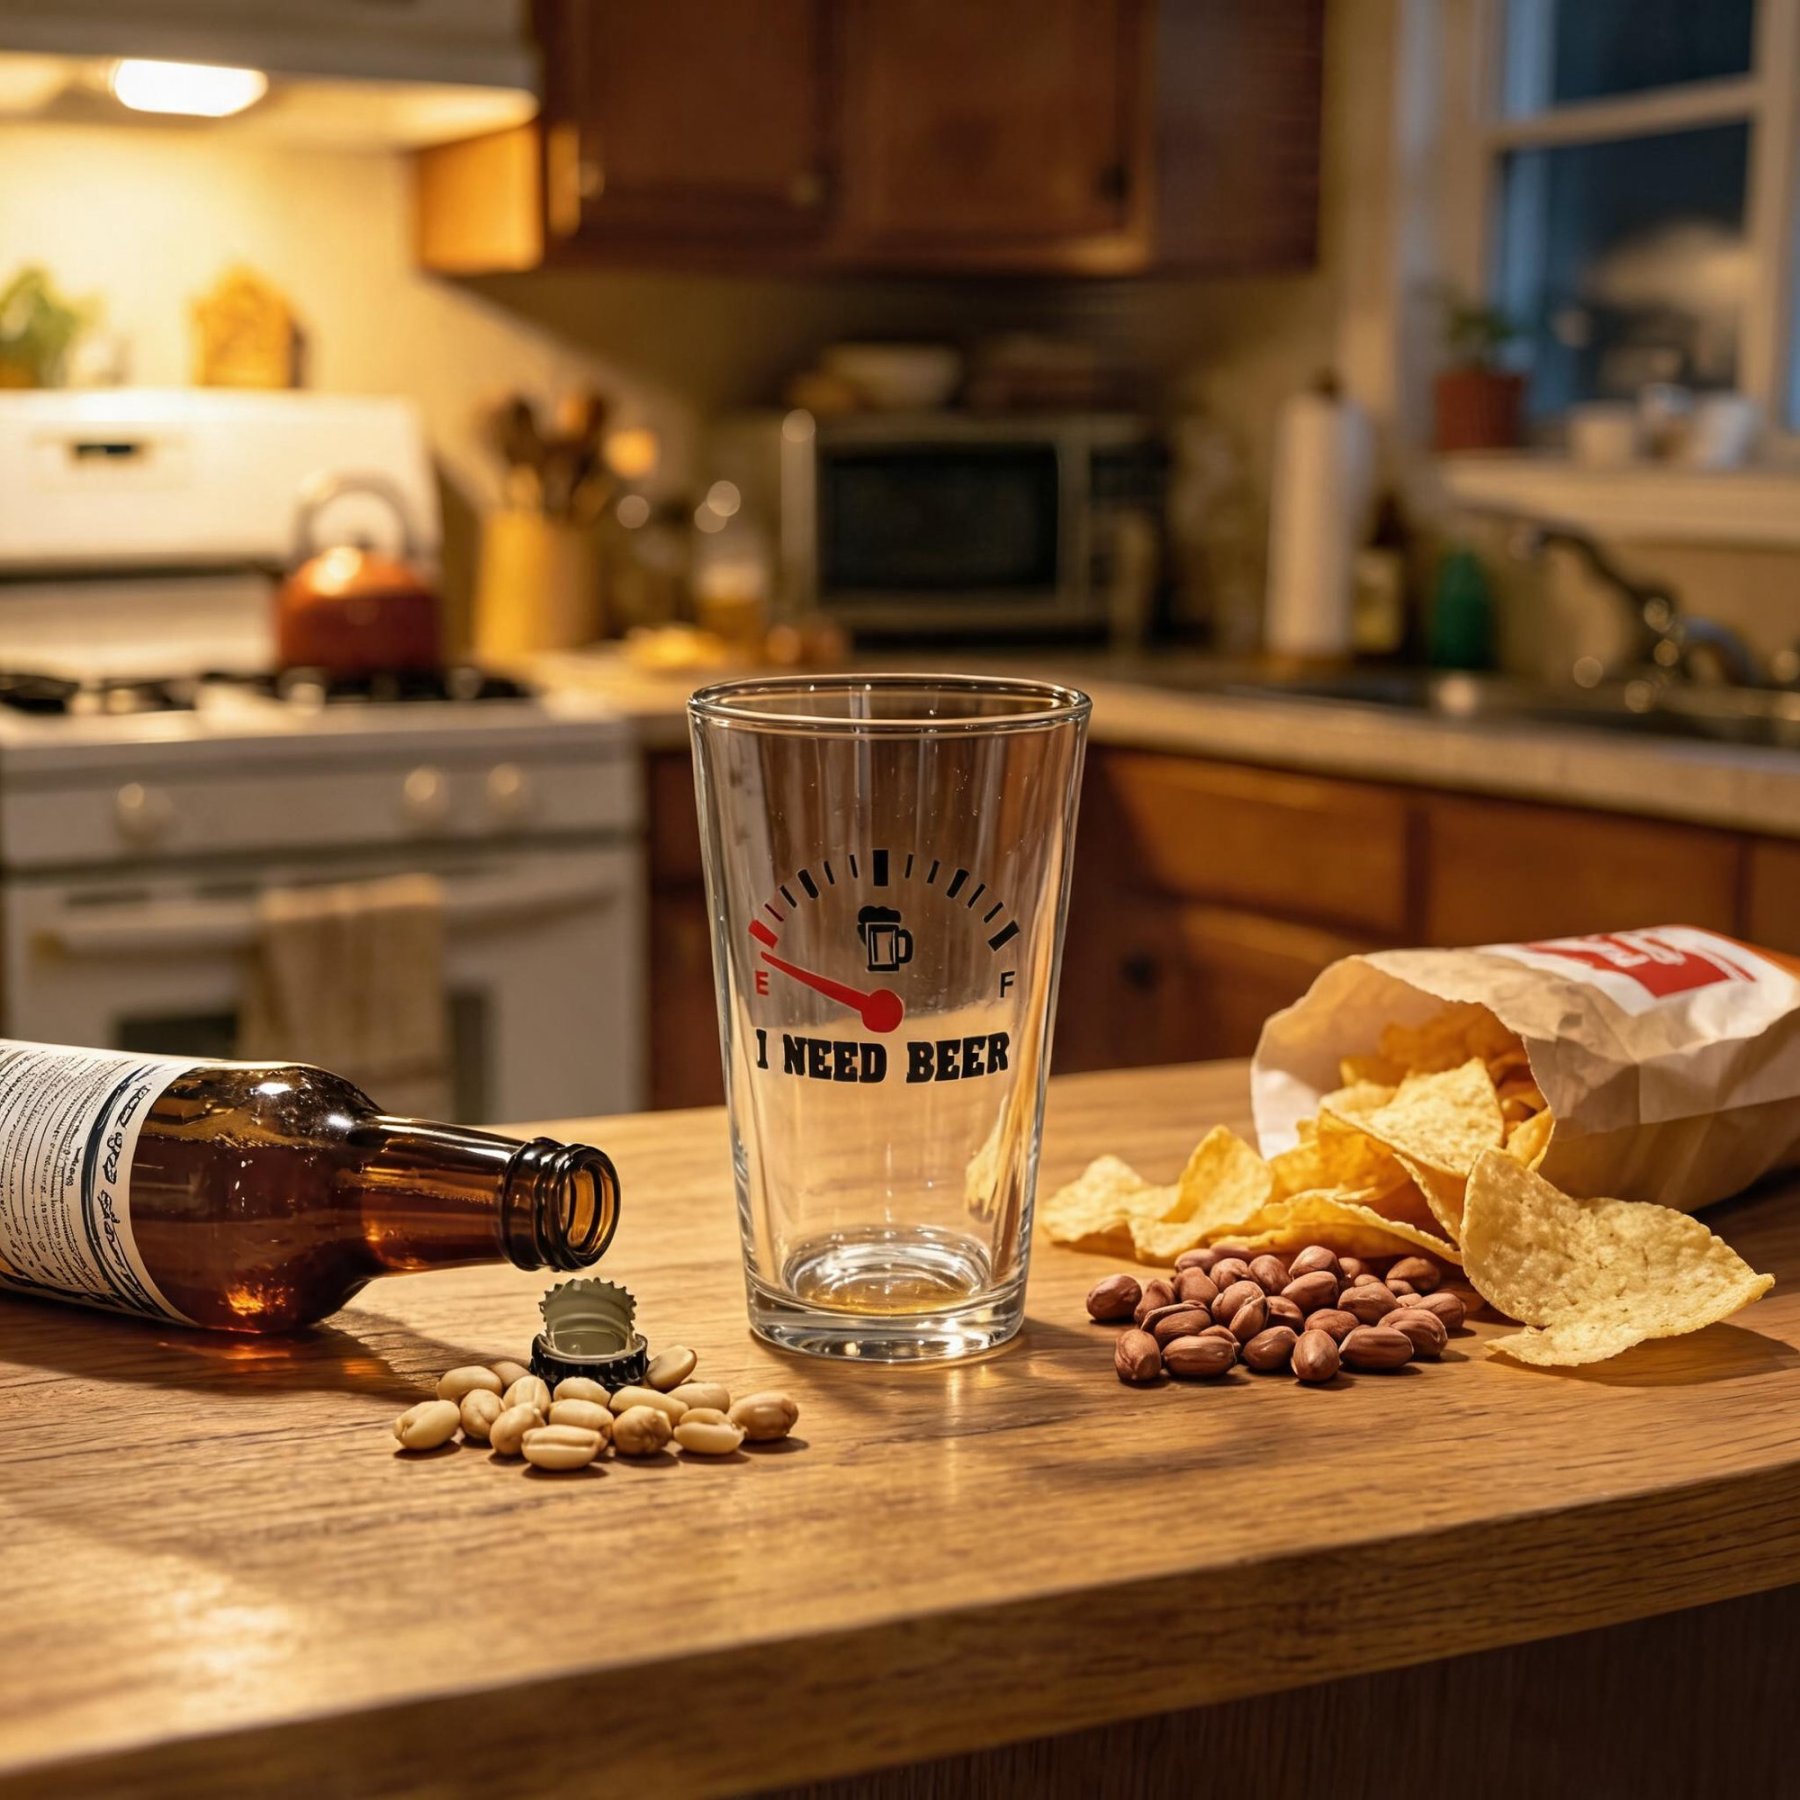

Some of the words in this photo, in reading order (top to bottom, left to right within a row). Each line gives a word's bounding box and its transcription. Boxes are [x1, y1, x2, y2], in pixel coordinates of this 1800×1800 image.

[755, 970, 769, 996] E
[1000, 971, 1015, 998] F
[756, 1029, 769, 1070] I
[783, 1034, 887, 1083] NEED
[906, 1032, 1010, 1083] BEER
